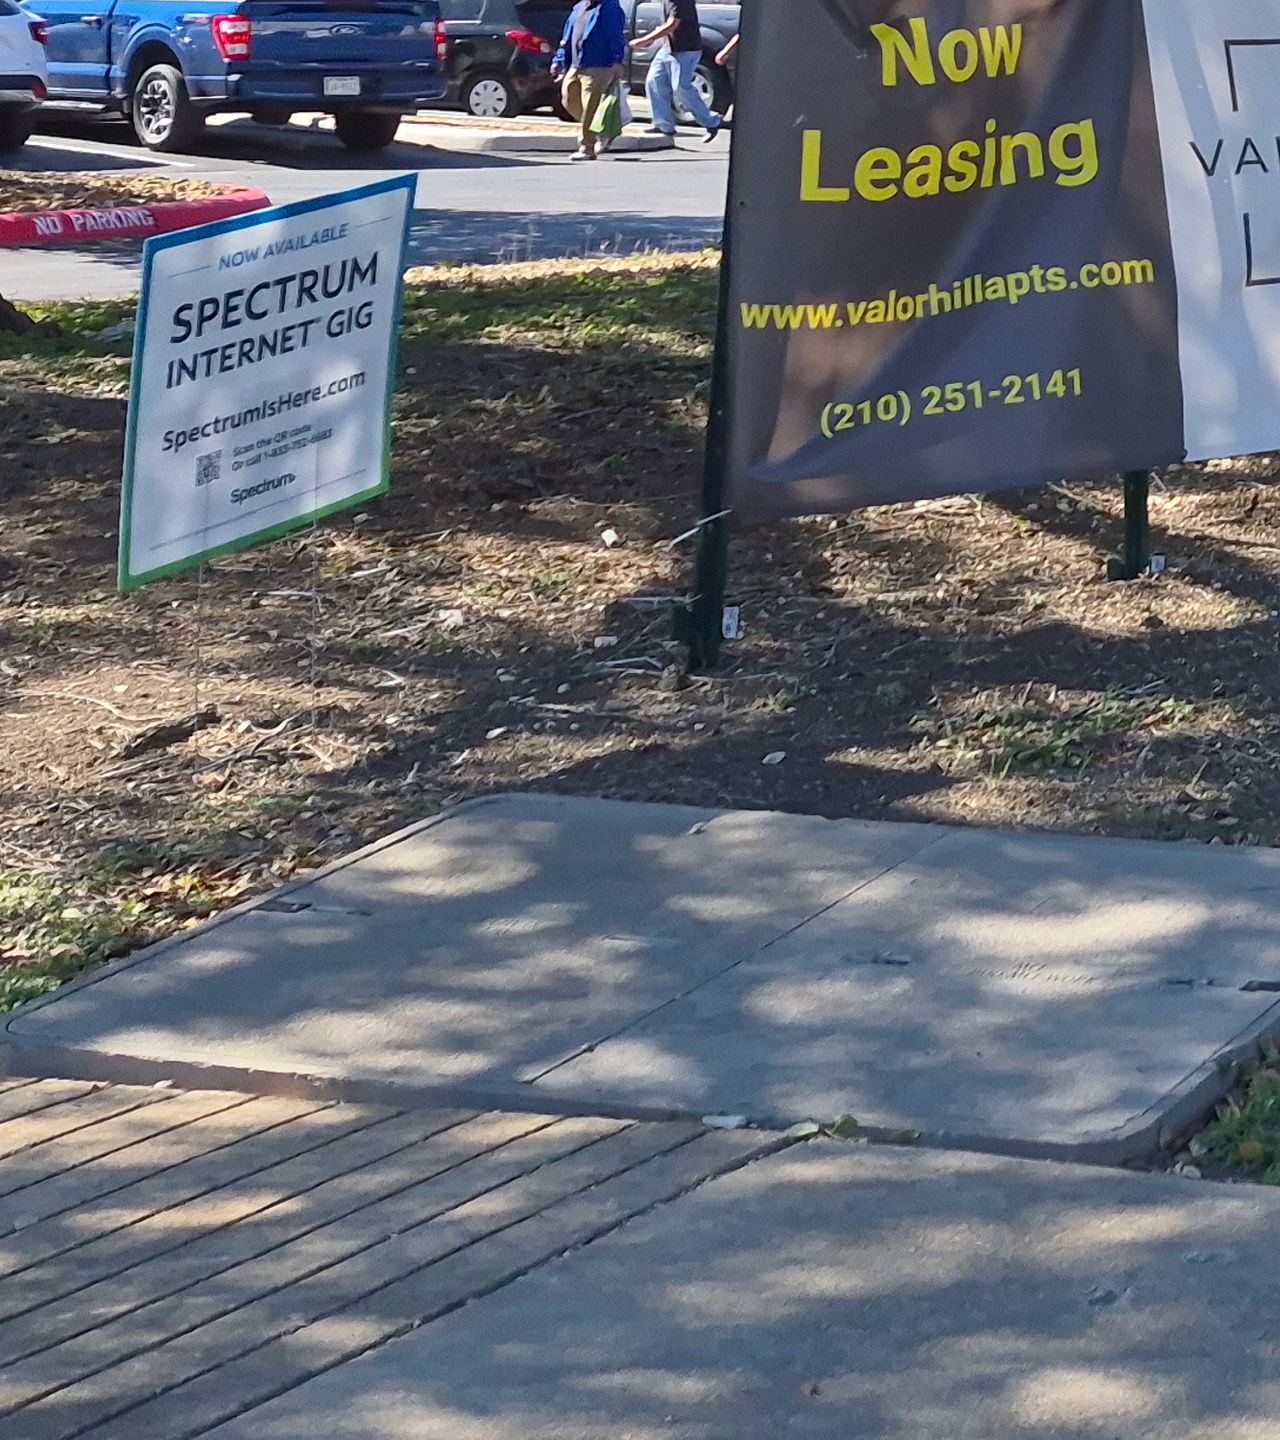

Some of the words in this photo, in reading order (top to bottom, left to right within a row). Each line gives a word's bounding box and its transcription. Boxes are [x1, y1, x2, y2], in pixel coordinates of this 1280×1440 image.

[870, 17, 1022, 86] Now
[799, 118, 1099, 202] Leasing
[33, 216, 64, 236] NO
[70, 210, 155, 231] PARKING
[218, 248, 260, 270] NOW
[263, 222, 349, 259] AVAILABLE
[170, 251, 379, 344] SPECTRUM
[740, 259, 1154, 330] www.valorhillapts.com
[166, 318, 316, 389] INTERNET
[326, 301, 374, 339] GIG
[162, 371, 366, 453] SpectrumIsHere.com
[820, 390, 911, 438] (210)
[921, 368, 1083, 416] 251-2141
[232, 443, 255, 457] Scan
[256, 437, 272, 448] the
[273, 430, 288, 443] QR
[231, 472, 293, 505] Spectrum
